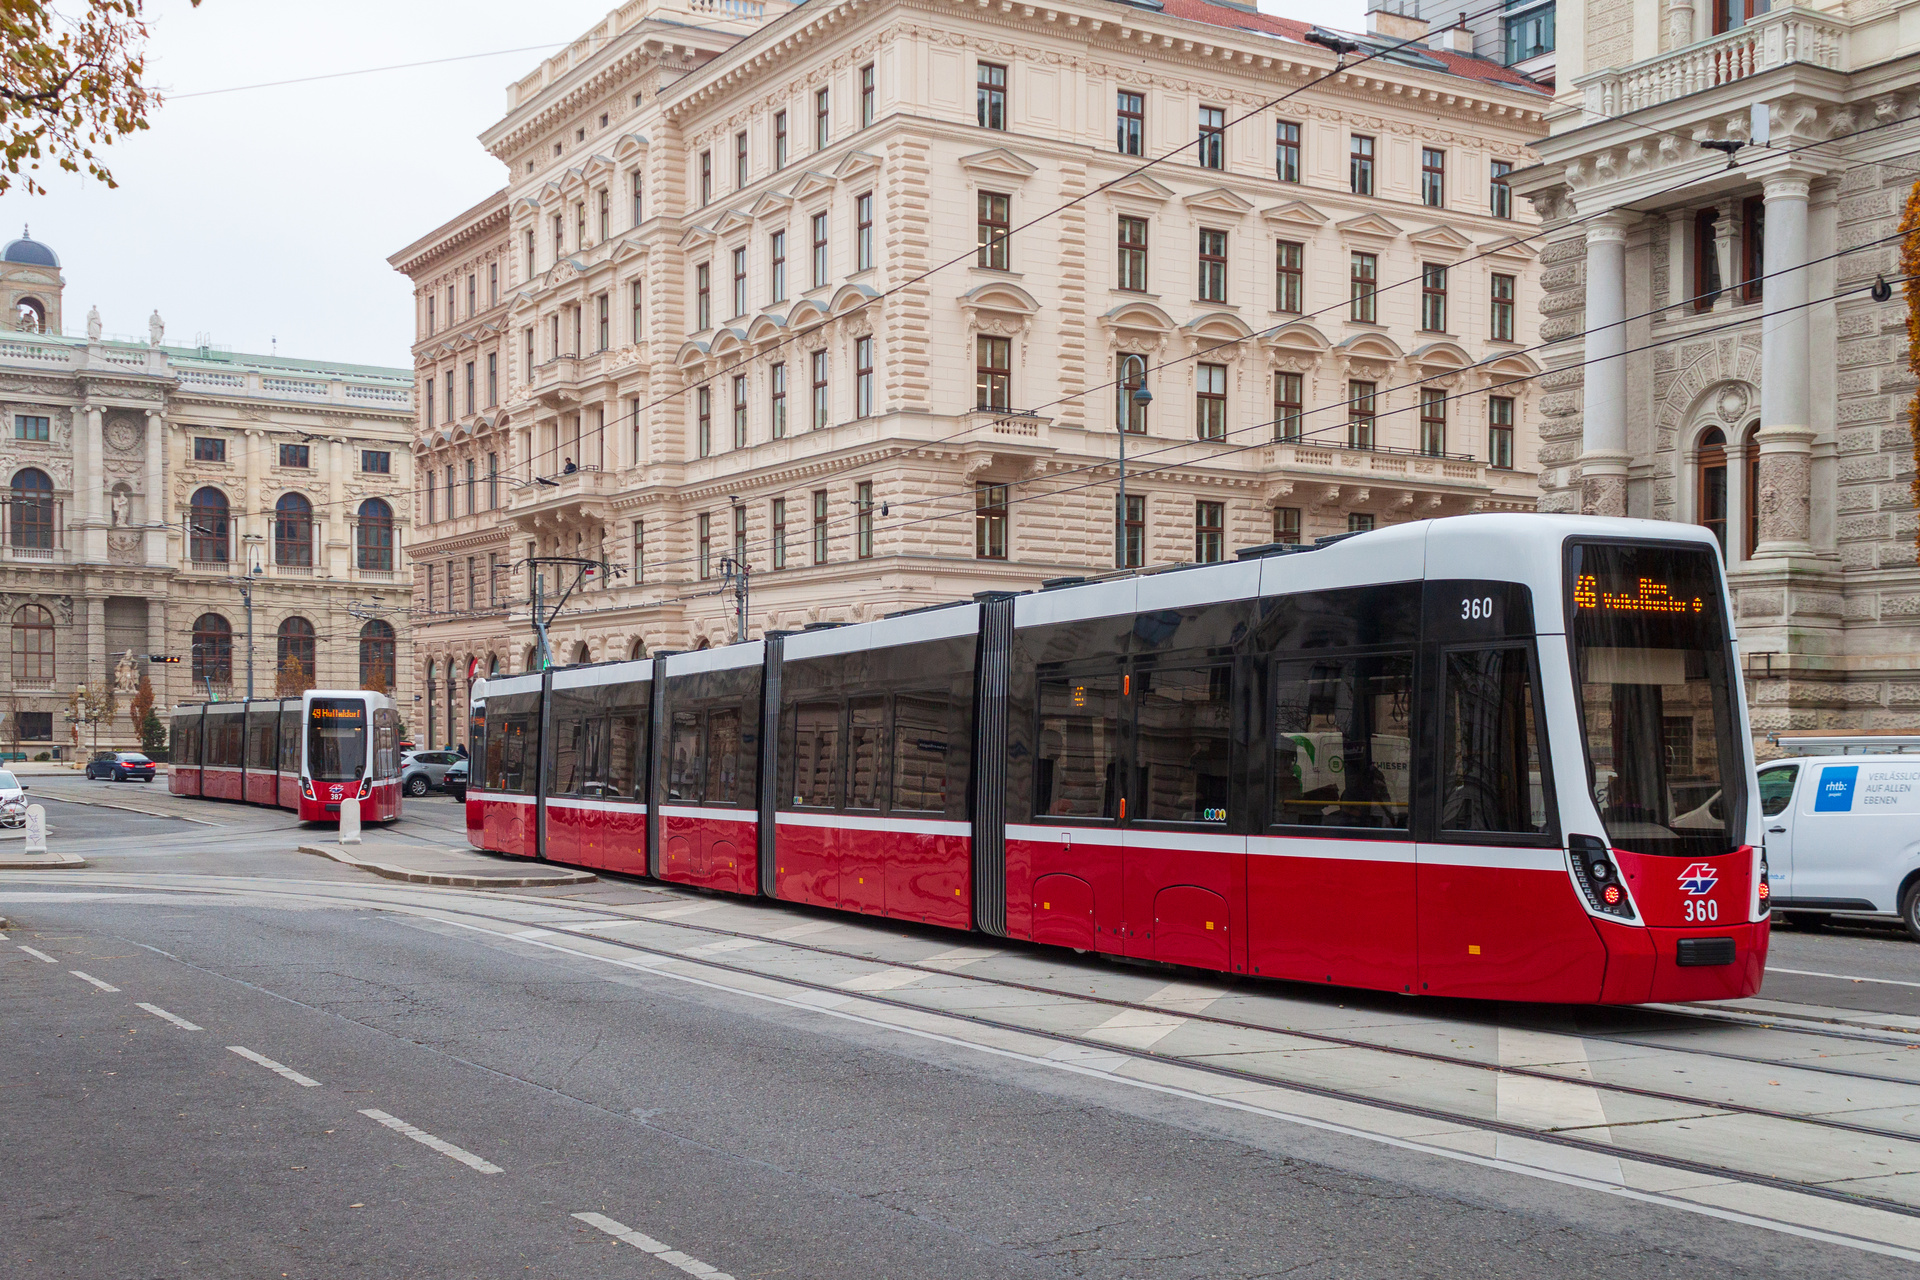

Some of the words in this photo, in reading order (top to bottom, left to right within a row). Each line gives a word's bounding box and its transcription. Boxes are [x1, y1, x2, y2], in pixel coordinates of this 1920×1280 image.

[1574, 575, 1596, 608] 46
[1461, 597, 1493, 620] 360
[312, 708, 322, 719] 49
[1865, 784, 1883, 793] AUF
[1884, 784, 1912, 793] ALLEN
[331, 793, 343, 801] 387
[1863, 796, 1898, 805] EBENEN
[1683, 899, 1718, 922] 360
